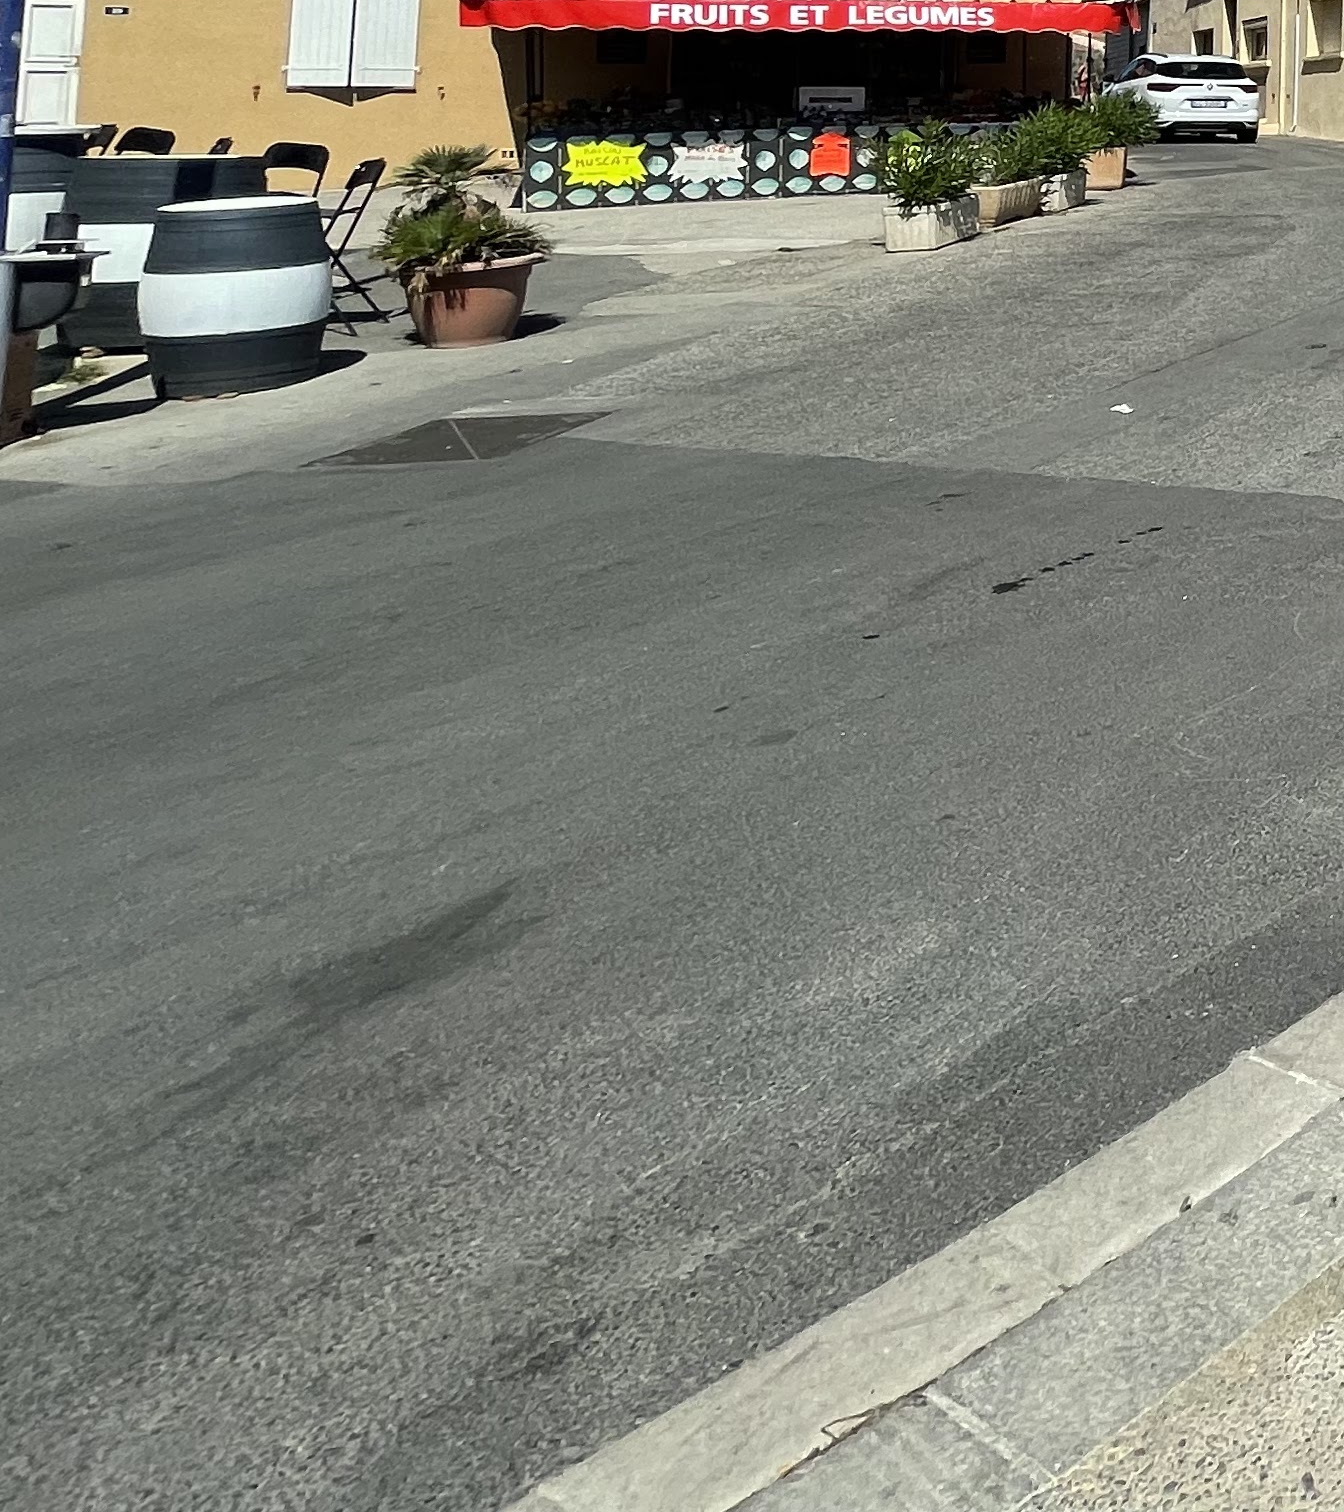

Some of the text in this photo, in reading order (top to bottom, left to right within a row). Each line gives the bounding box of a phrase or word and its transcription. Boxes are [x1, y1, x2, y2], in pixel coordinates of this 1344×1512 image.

[649, 2, 995, 27] FRUITS ET LEGUMES
[575, 156, 636, 168] MUSCAT
